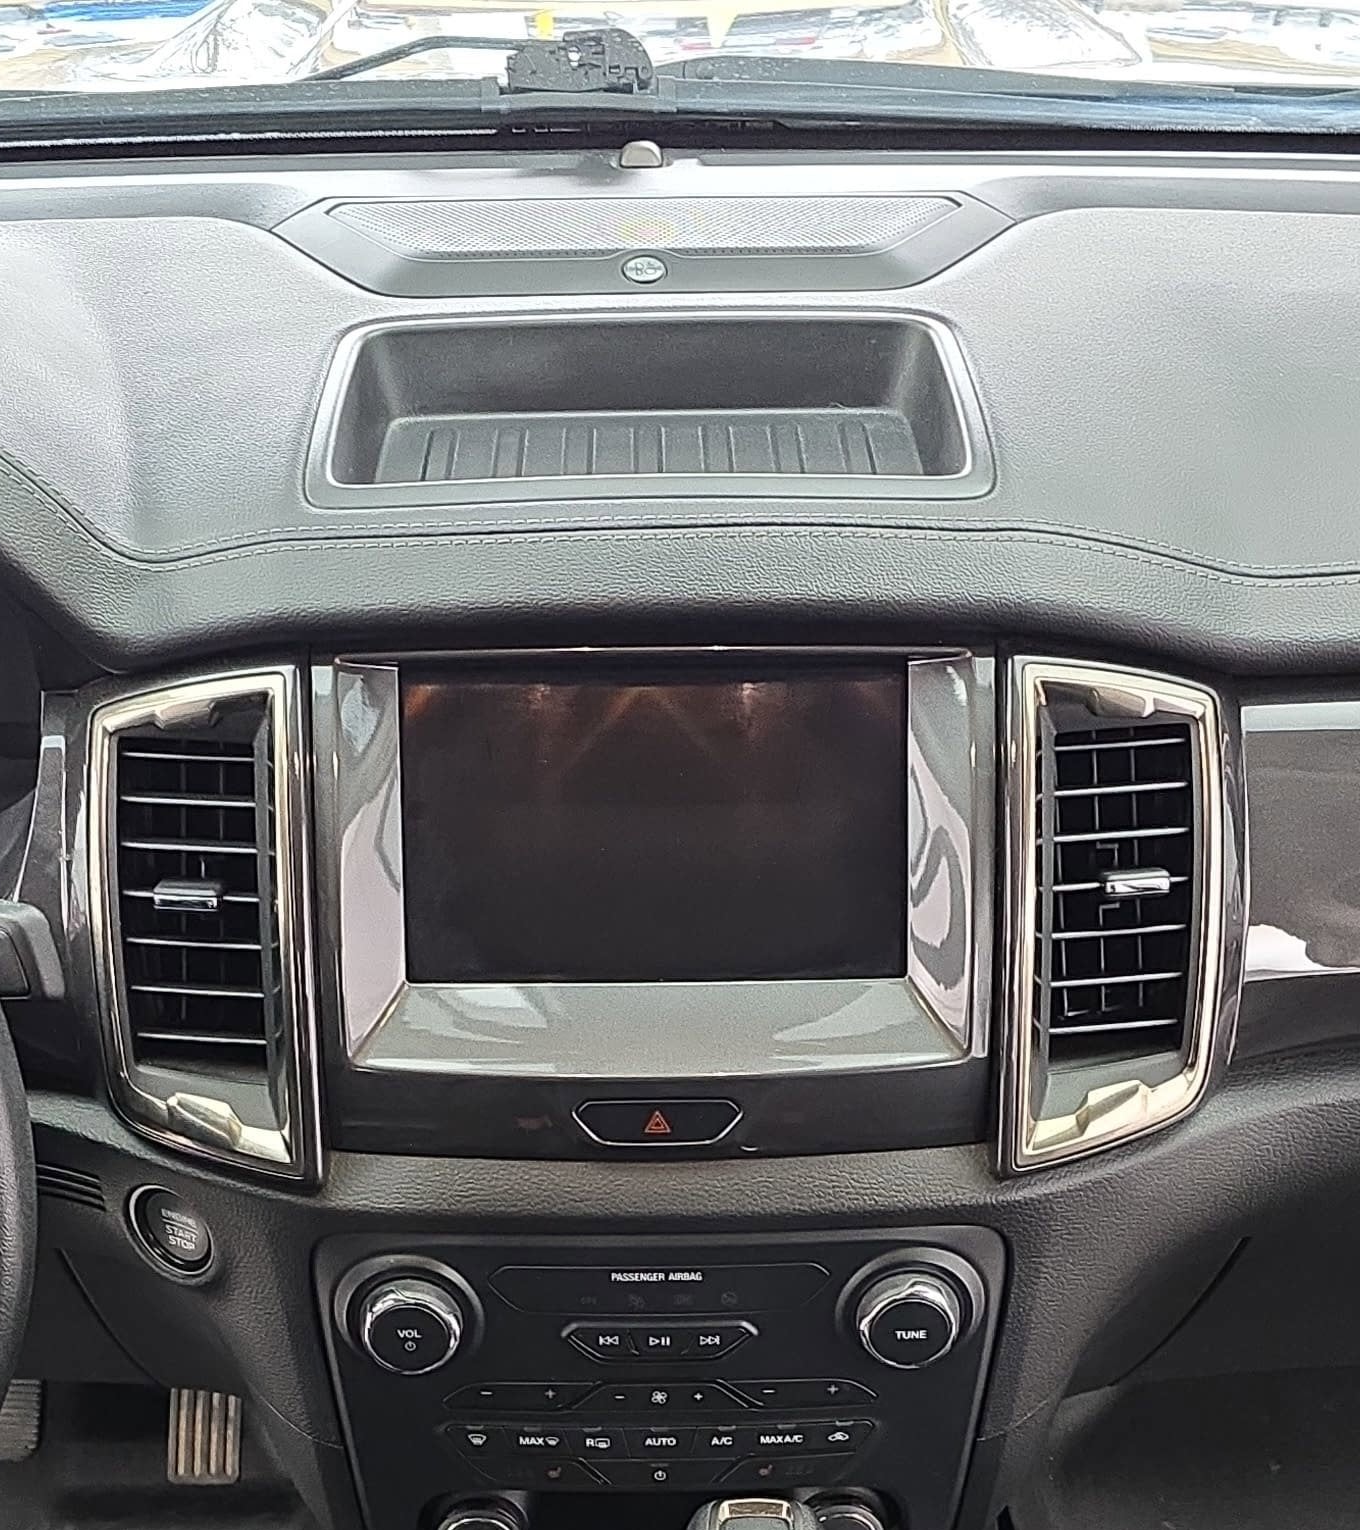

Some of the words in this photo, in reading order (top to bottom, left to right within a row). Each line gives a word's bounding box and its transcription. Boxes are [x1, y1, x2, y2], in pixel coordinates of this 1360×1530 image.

[165, 1223, 198, 1242] START
[168, 1235, 195, 1249] STOP
[610, 1272, 666, 1283] PASSENGER
[667, 1271, 703, 1282] AIRBAG
[396, 1328, 422, 1340] VOL
[894, 1328, 928, 1341] TUNE
[519, 1436, 545, 1446] MAX
[644, 1437, 677, 1447] AUTO
[711, 1436, 733, 1446] A/C
[759, 1435, 784, 1445] MAX
[783, 1434, 804, 1444] A/C
